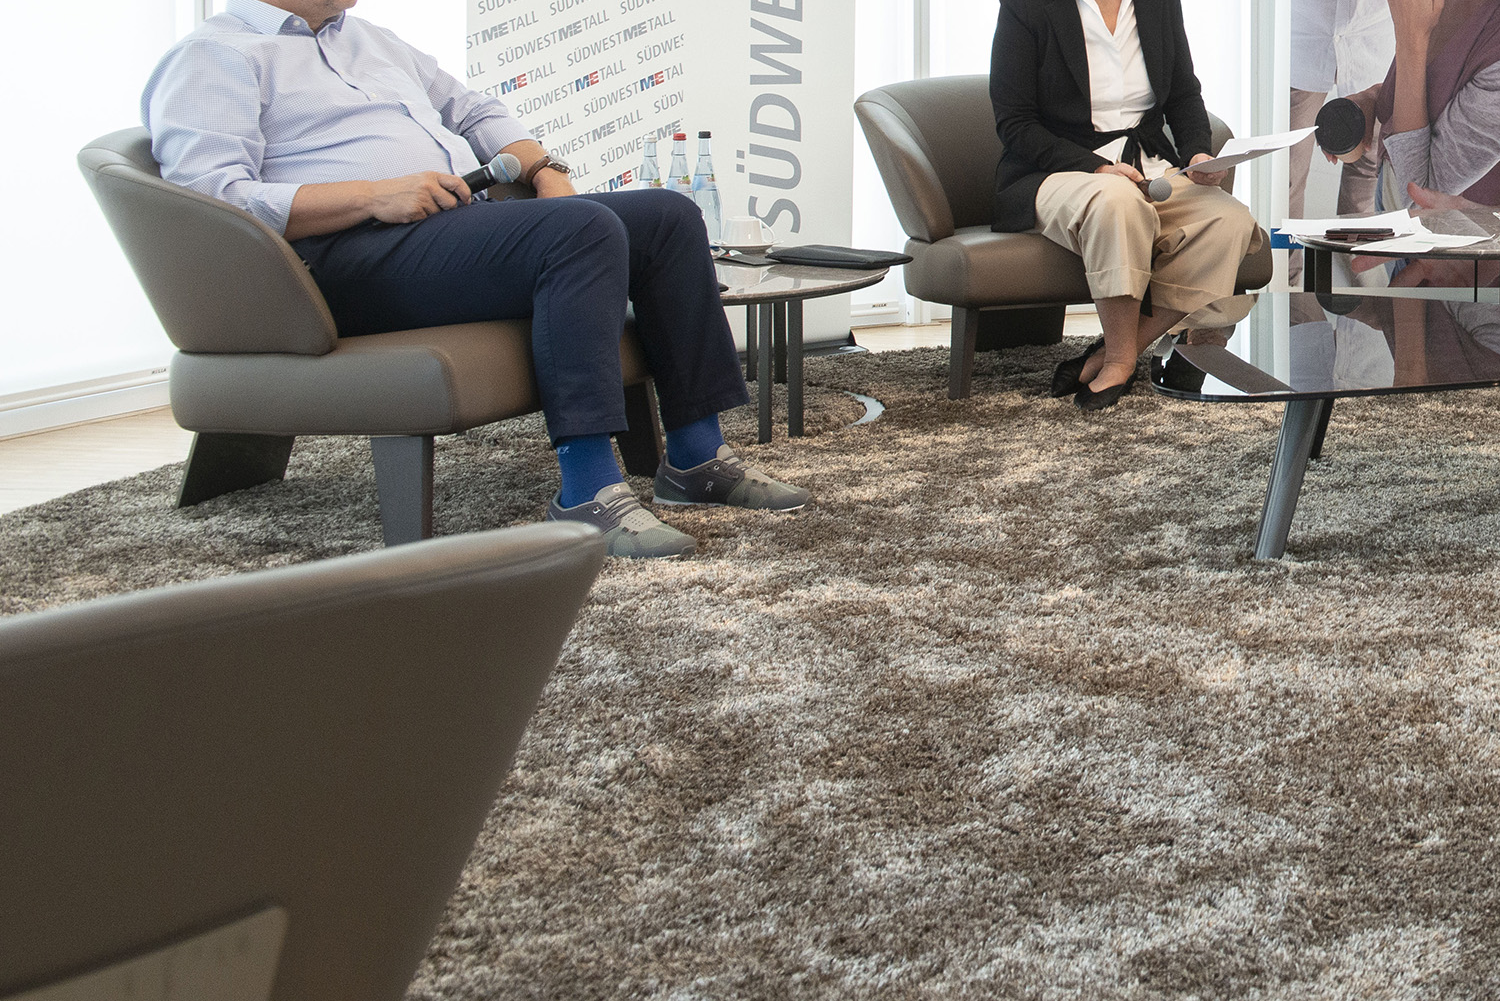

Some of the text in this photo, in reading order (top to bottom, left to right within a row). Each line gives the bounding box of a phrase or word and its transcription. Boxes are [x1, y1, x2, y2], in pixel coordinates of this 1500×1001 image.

[479, 11, 676, 98] STMETALL SÜDWESTMETALL
[498, 10, 610, 67] SÜDWESTMETALL
[516, 60, 626, 118] SÜDWESTMETALL
[546, 109, 643, 157] DWESTMETALL
